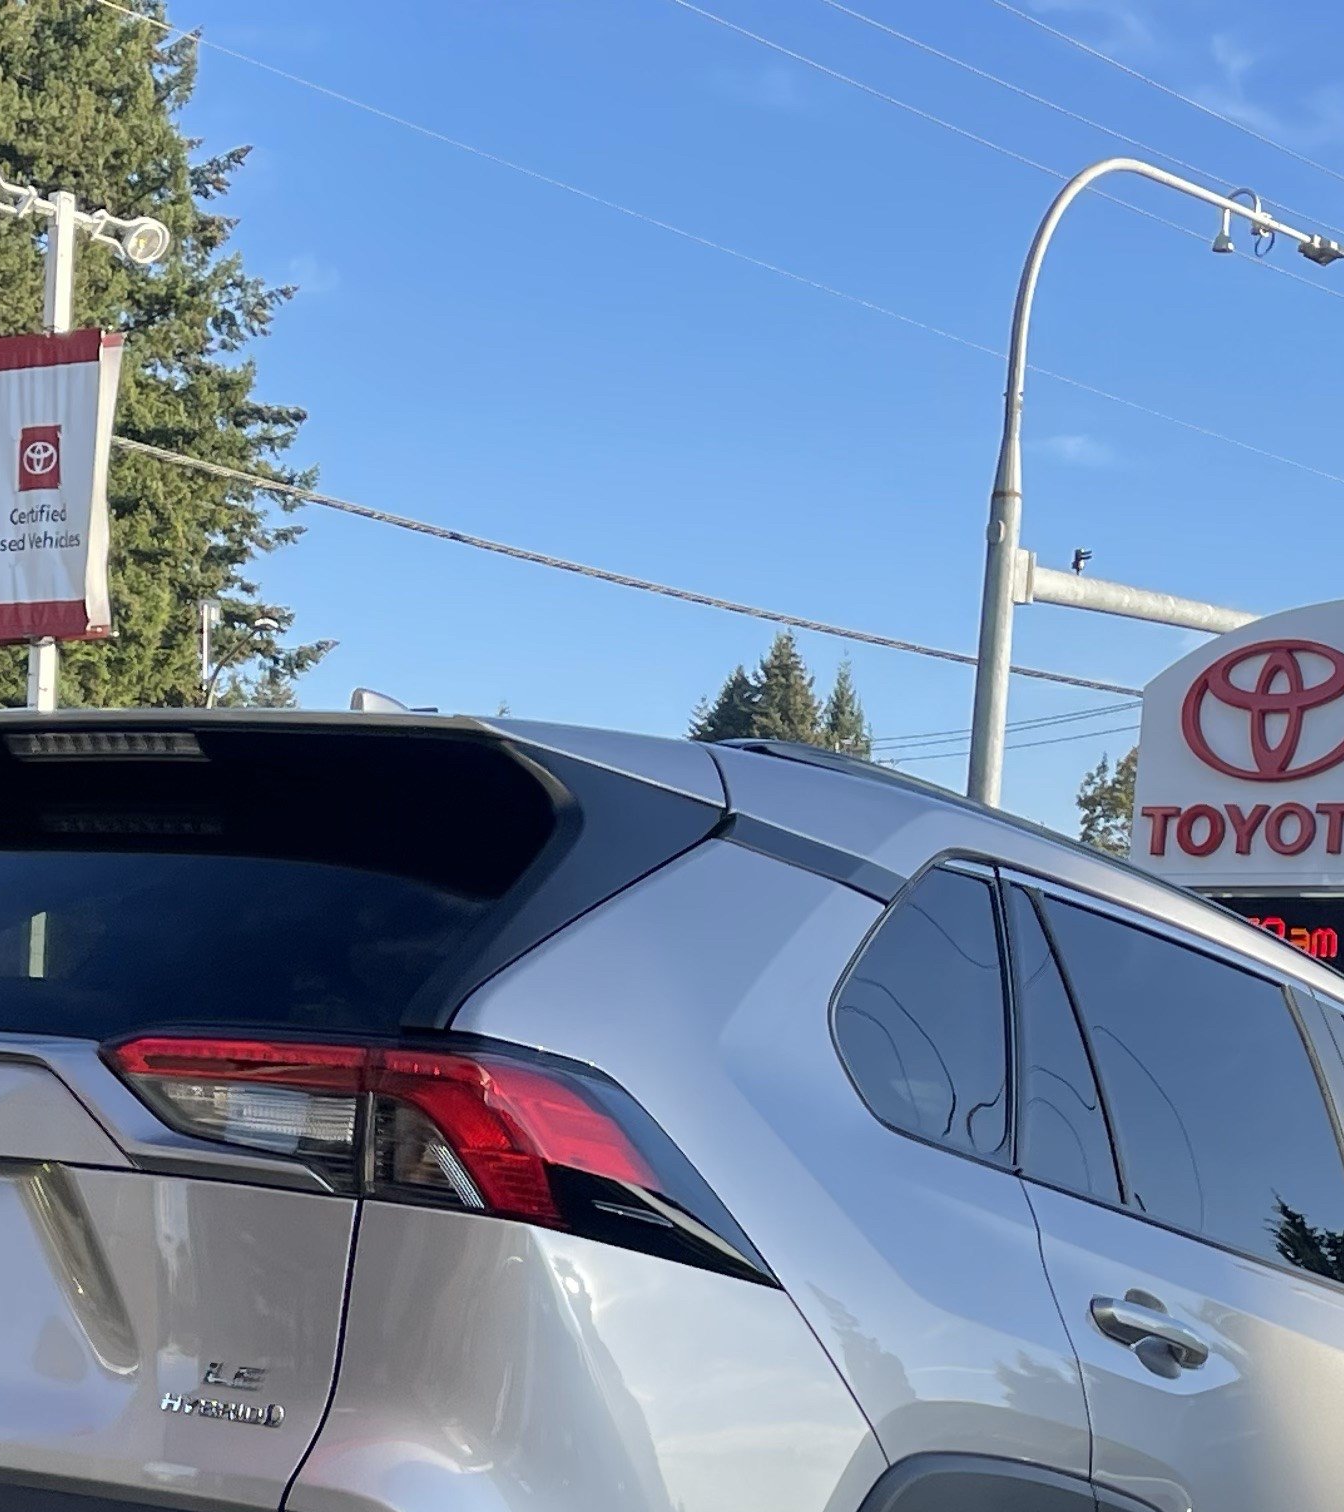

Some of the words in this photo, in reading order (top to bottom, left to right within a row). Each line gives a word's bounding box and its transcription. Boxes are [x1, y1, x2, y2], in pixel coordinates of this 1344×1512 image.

[9, 502, 68, 526] Certified
[28, 530, 81, 550] Vehicles
[202, 1361, 269, 1392] LE
[159, 1392, 287, 1429] HYBRID
